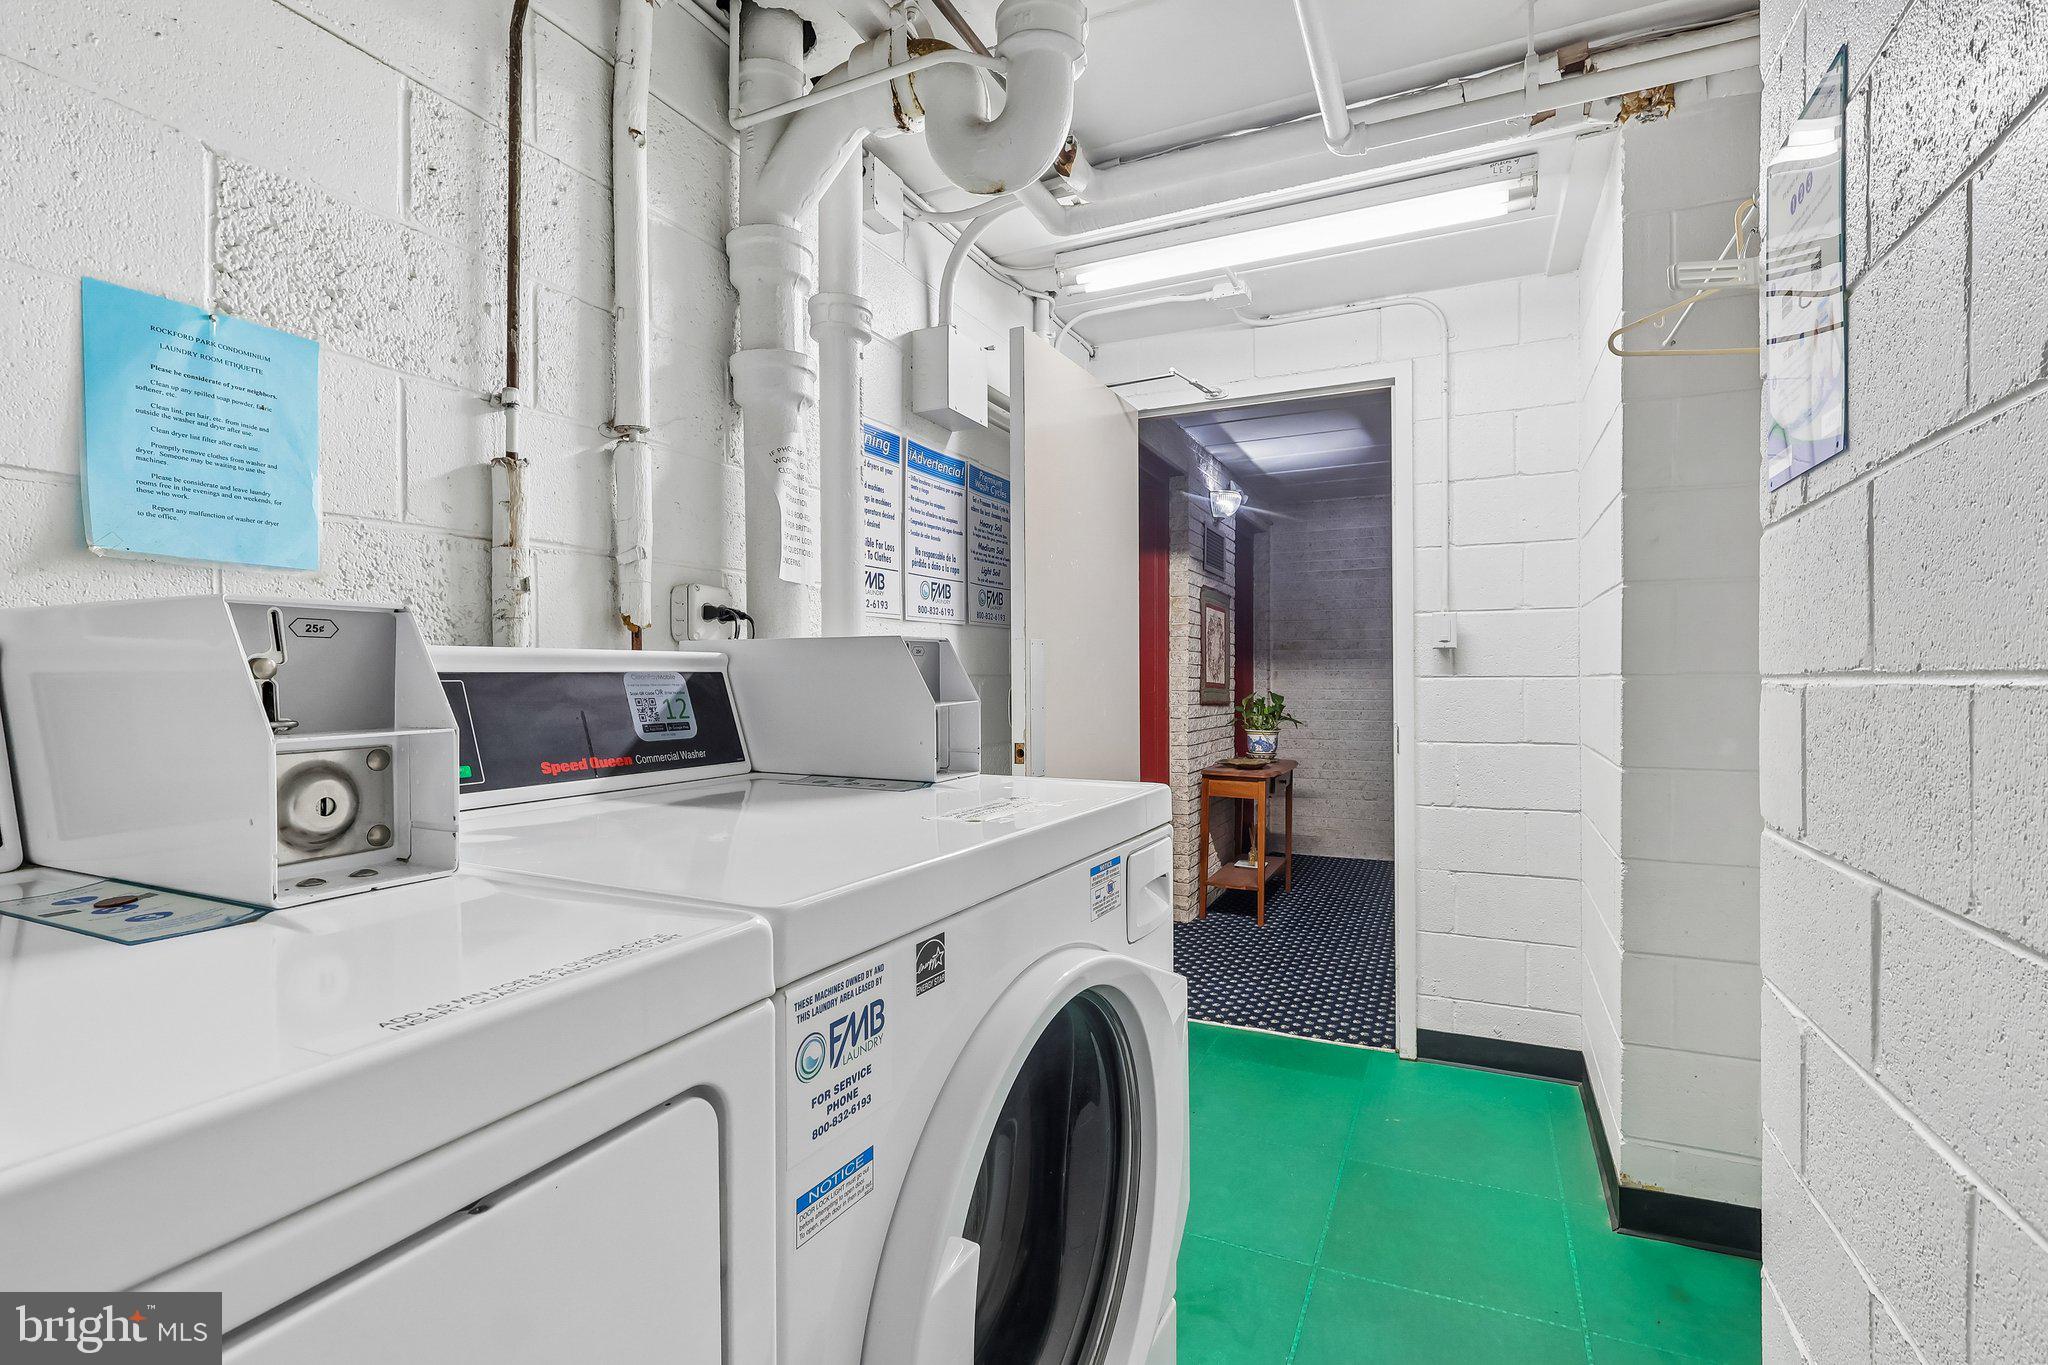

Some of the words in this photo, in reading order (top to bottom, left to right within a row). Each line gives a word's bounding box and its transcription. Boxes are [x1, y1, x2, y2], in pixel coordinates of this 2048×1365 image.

[150, 325, 194, 341] ROCKFORD
[196, 337, 216, 347] PARK
[218, 344, 271, 362] CONDOMINIUM
[160, 343, 197, 358] LAUNDRY
[200, 354, 223, 364] ROOM
[225, 360, 263, 375] ETIQUETTE
[136, 385, 164, 395] softener,
[151, 364, 172, 374] Please
[184, 373, 221, 385] considerate
[247, 387, 278, 399] neighbors.
[150, 380, 169, 389] Clean
[194, 390, 215, 399] spilled
[217, 394, 230, 403] soap
[232, 398, 255, 409] powder,
[136, 408, 160, 417] outside
[173, 415, 195, 424] washer
[210, 423, 226, 431] dryer
[151, 403, 169, 412] Clean
[197, 412, 211, 421] hair,
[225, 419, 239, 427] from
[241, 422, 258, 430] inside
[151, 426, 169, 435] Clean
[171, 431, 188, 439] dryer
[202, 436, 217, 444] filter
[136, 447, 155, 455] dryer.
[160, 451, 189, 462] Someone
[191, 457, 203, 465] may
[214, 461, 236, 471] waiting
[136, 455, 168, 466] machines.
[151, 442, 180, 454] Promptly
[182, 448, 206, 456] remove
[207, 453, 228, 461] clothes
[246, 460, 266, 468] washer
[136, 487, 154, 495] those
[151, 473, 172, 481] Please
[183, 478, 218, 489] considerate
[250, 489, 271, 497] laundry
[991, 486, 1007, 498] Cycles
[193, 489, 220, 497] evenings
[243, 495, 273, 505] weekends,
[152, 504, 174, 513] Report
[189, 510, 225, 520] malfunction
[158, 513, 178, 521] office.
[980, 519, 994, 530] Heavy
[868, 550, 873, 559] To
[874, 552, 892, 563] Clothes
[885, 542, 895, 552] Loss
[915, 547, 921, 556] No
[922, 549, 945, 560] responsable
[996, 547, 1004, 555] Soil
[993, 569, 1001, 577] Soil
[931, 582, 951, 602] FMB
[987, 590, 1003, 608] FMB
[918, 606, 954, 616] 800-832-6193
[305, 624, 324, 632] 25¢
[663, 698, 690, 719] 12
[541, 758, 588, 776] Speed
[590, 756, 633, 769] Queen
[635, 751, 679, 765] Commercial
[680, 749, 707, 760] Washer
[794, 996, 813, 1012] THESE
[814, 982, 845, 1003] MACHINES
[845, 972, 865, 988] OWNED
[866, 970, 873, 978] BY
[874, 963, 885, 975] AND
[796, 1008, 811, 1024] THIS
[812, 995, 838, 1018] LAUNDRY
[839, 989, 854, 1004] AREA
[855, 982, 875, 1000] LEASED
[875, 976, 883, 987] BY
[379, 1012, 423, 1028] ADD
[389, 1004, 464, 1031] INSERT
[830, 998, 885, 1069] FMB
[842, 1032, 884, 1066] LAUNDRY
[811, 1089, 831, 1109] FOR
[833, 1064, 872, 1096] SERVICE
[826, 1087, 859, 1115] PHONE
[812, 1094, 872, 1140] 800-832-6193
[809, 1154, 864, 1203] NOTICE
[800, 1206, 815, 1222] DOOR
[816, 1196, 830, 1210] LOCK
[831, 1185, 845, 1198] LIGHT
[846, 1177, 856, 1187] must
[857, 1172, 862, 1181] go
[820, 1213, 831, 1225] push
[832, 1205, 842, 1215] door
[857, 1186, 865, 1195] pull
[799, 1217, 814, 1231] before
[815, 1199, 838, 1219] attempting
[844, 1187, 854, 1198] open
